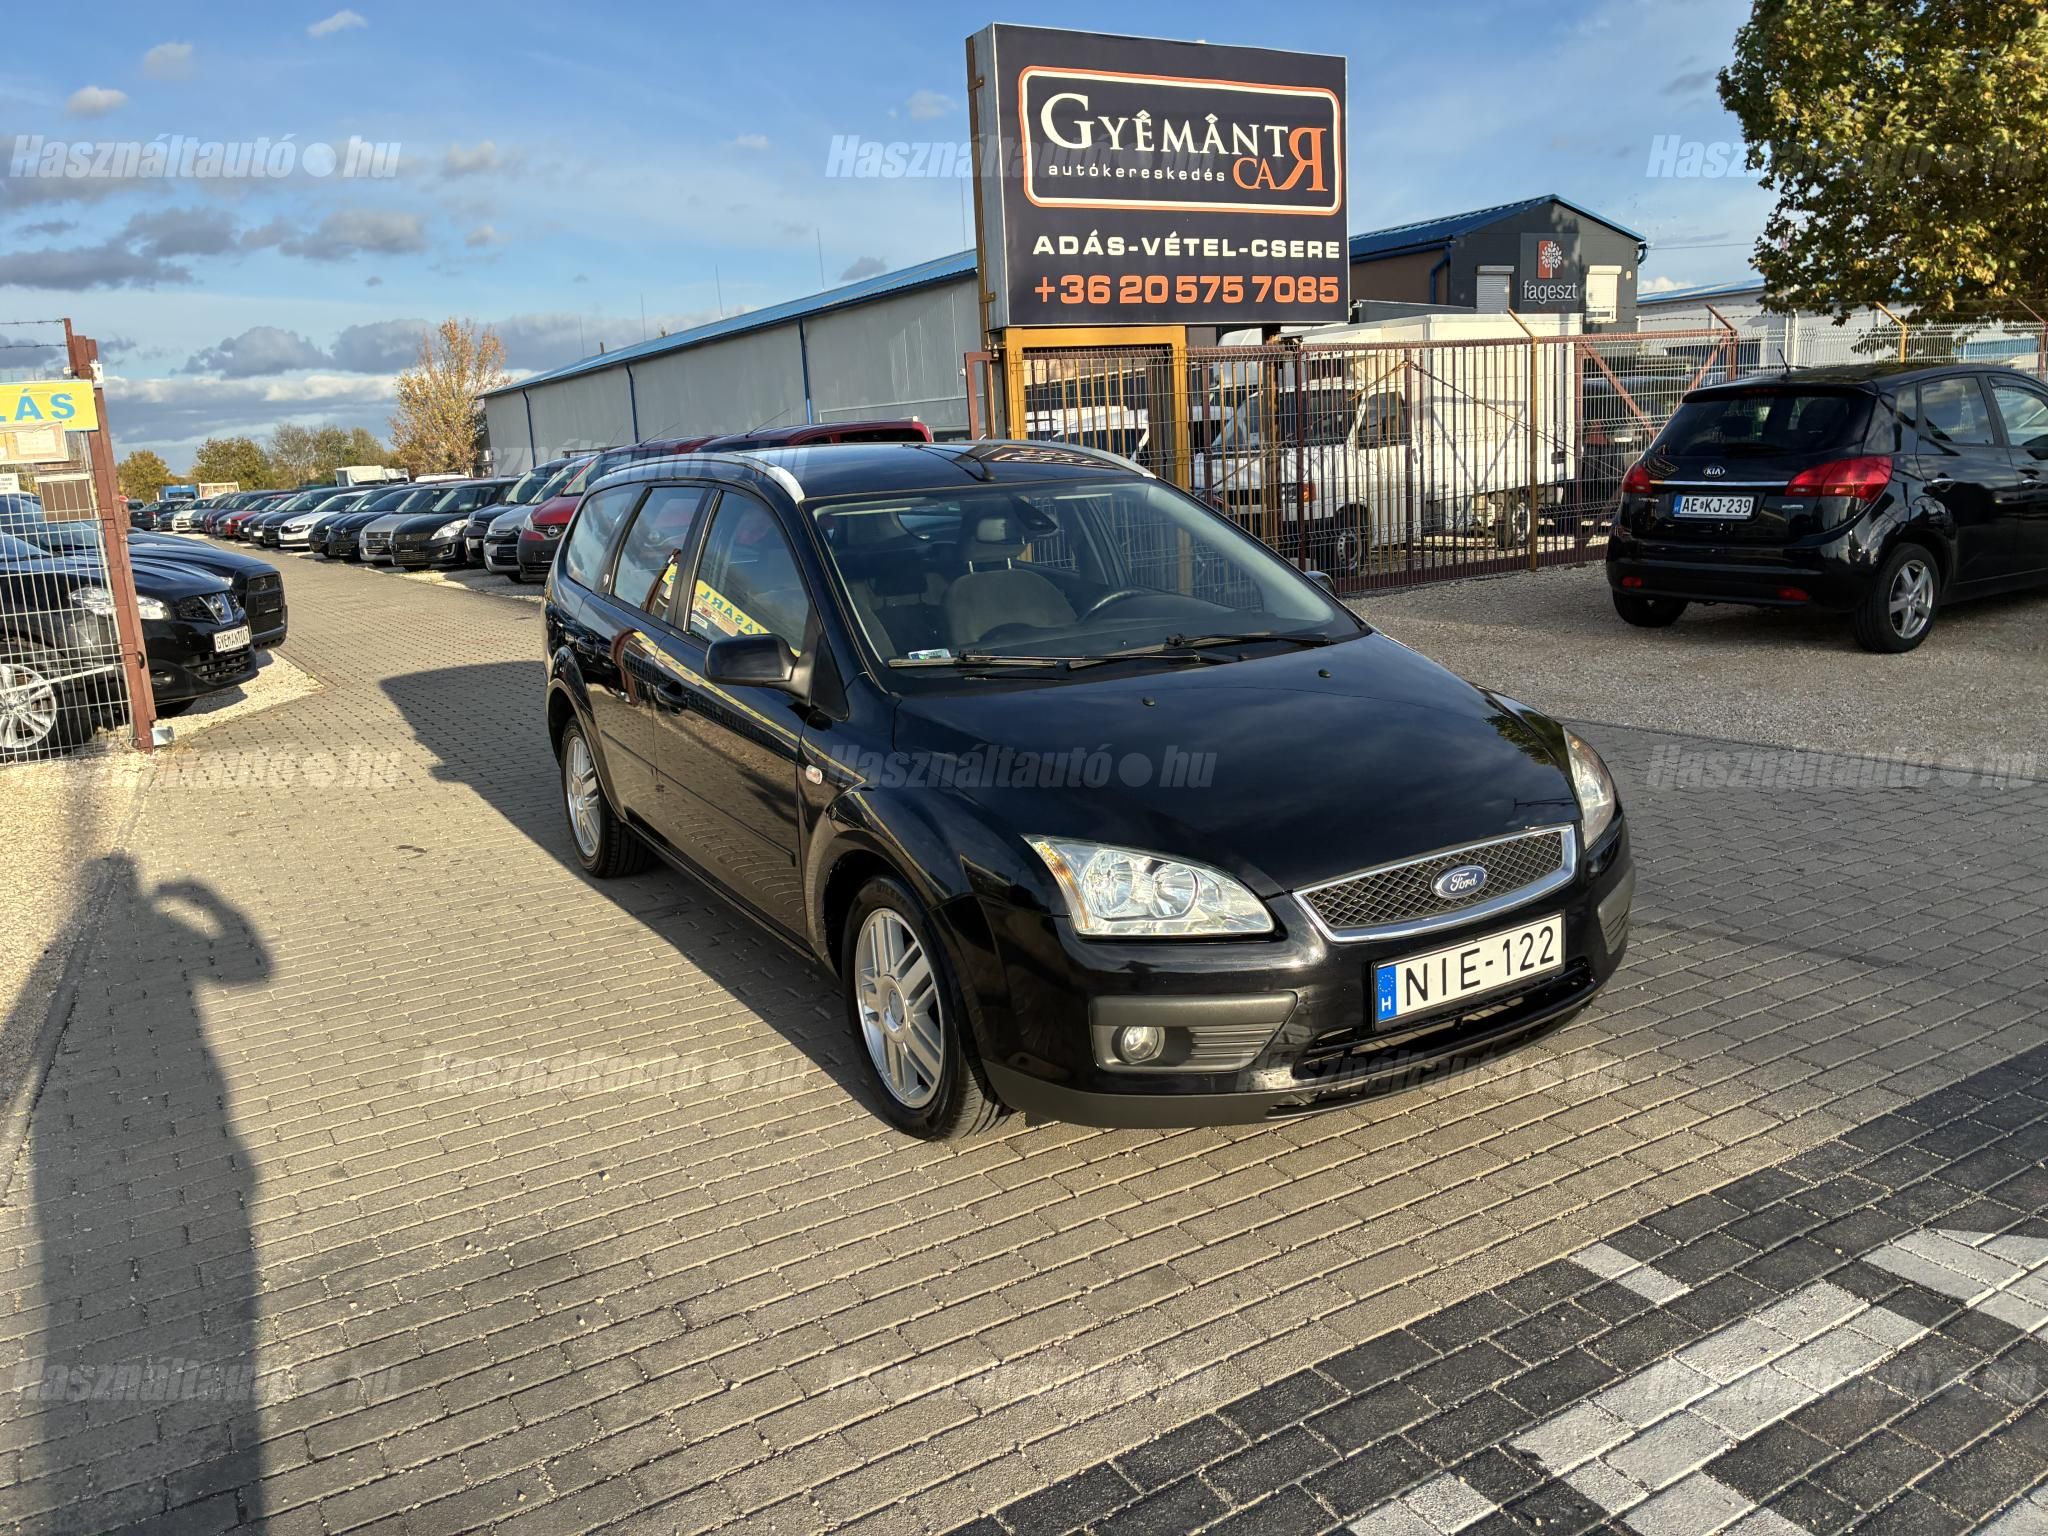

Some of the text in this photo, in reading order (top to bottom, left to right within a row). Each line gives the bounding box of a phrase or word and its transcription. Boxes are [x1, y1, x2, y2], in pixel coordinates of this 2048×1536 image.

[1048, 162, 1225, 182] autókereskedés
[1034, 275, 1339, 304] +36 20 575 7085
[1523, 280, 1578, 304] fageszt
[1706, 467, 1721, 475] KIA
[1450, 871, 1478, 892] Ford
[1381, 926, 1554, 1012] H NIE-122
